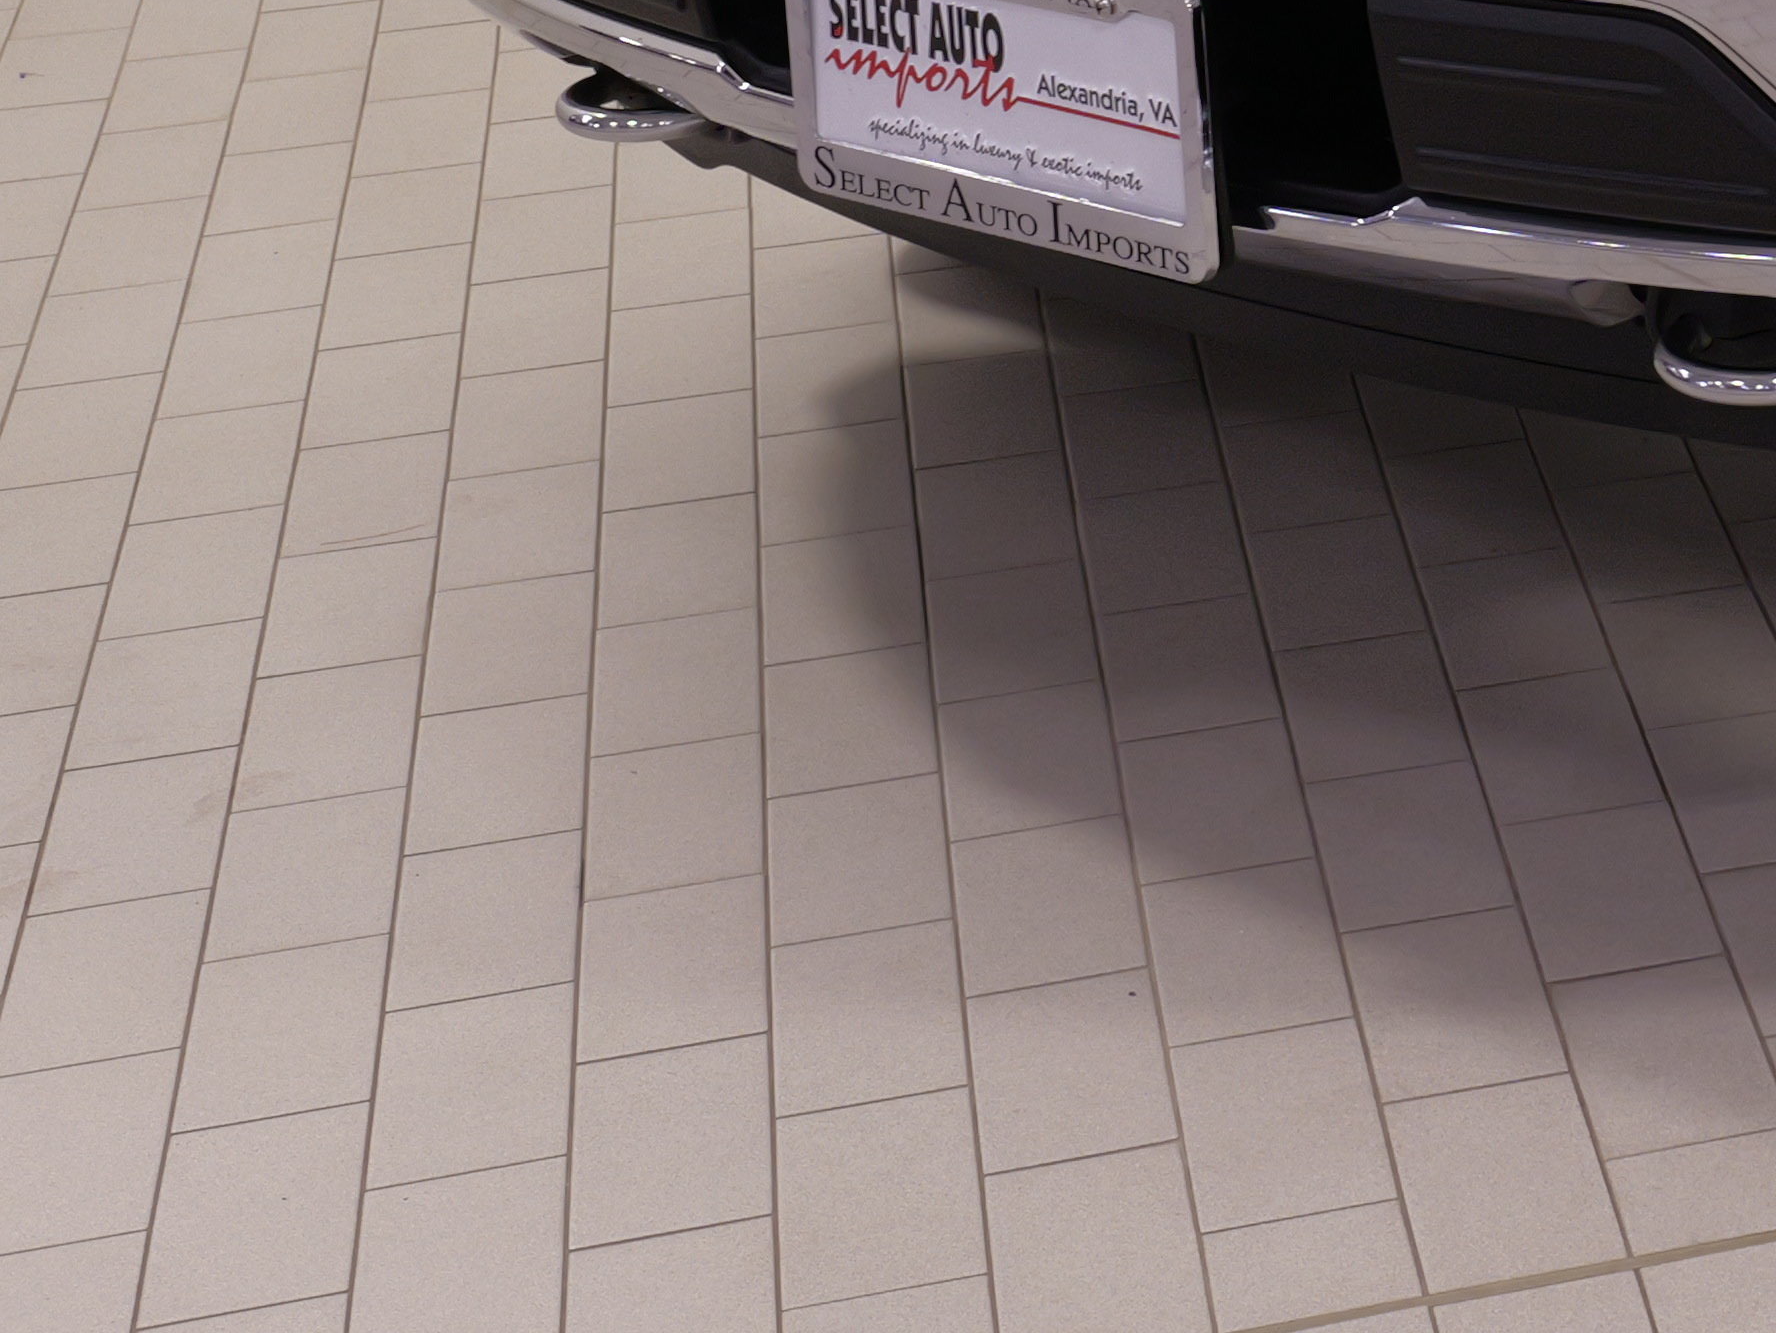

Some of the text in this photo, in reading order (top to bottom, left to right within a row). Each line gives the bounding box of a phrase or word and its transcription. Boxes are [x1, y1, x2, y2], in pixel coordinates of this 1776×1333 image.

[824, 25, 1021, 113] imports
[928, 1, 1004, 74] AUTO
[1036, 73, 1178, 128] Alexandria, VA
[868, 118, 949, 156] specializing
[951, 130, 970, 152] in
[973, 133, 1024, 172] luxury
[1042, 156, 1083, 178] exotic
[1083, 162, 1145, 193] imports
